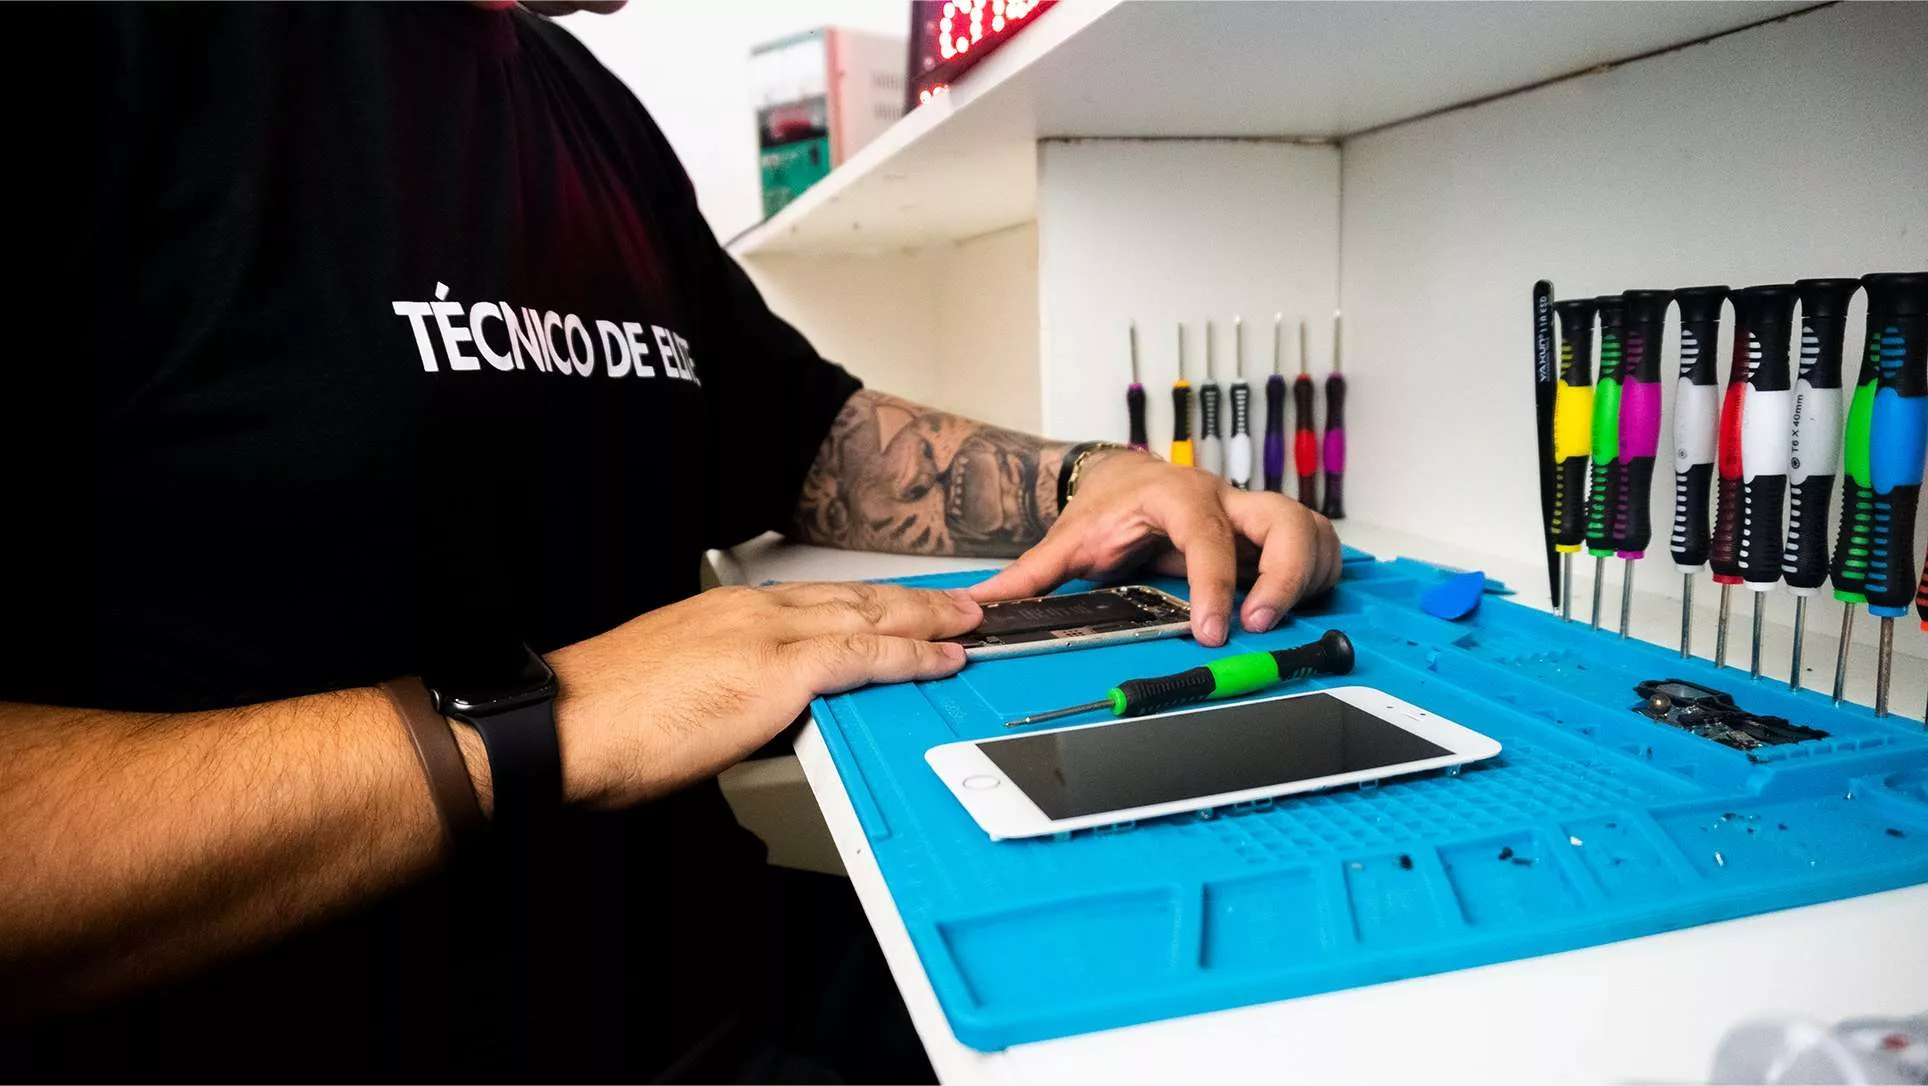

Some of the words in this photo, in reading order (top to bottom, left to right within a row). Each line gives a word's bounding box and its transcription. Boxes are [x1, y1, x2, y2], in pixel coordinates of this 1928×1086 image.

[391, 281, 594, 378] TÉCNICO
[595, 319, 655, 378] DE
[1792, 394, 1804, 427] 40mm
[1791, 440, 1799, 453] T6
